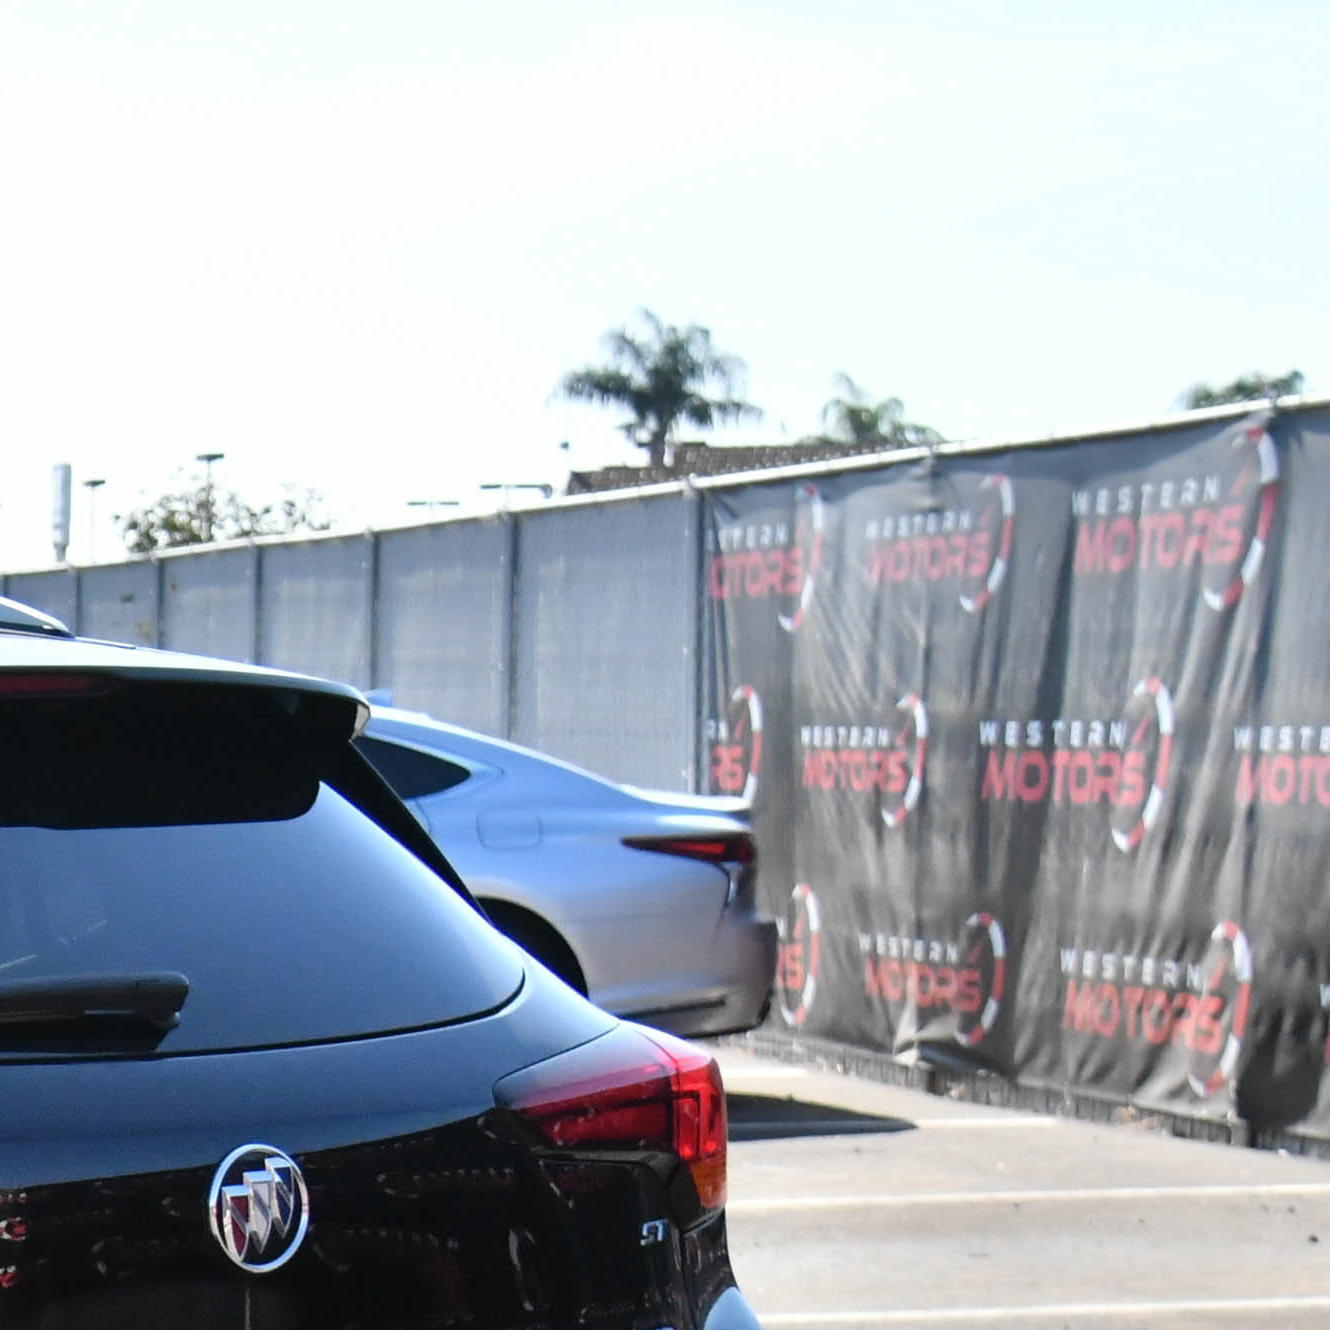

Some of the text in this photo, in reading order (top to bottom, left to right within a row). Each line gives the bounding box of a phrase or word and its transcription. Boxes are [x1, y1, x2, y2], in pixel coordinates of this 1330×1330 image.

[1072, 475, 1220, 516] WESTERN
[865, 509, 973, 540] WESTERN
[1074, 503, 1244, 575] MOTORS
[866, 531, 990, 588] MOTORS
[801, 725, 890, 748] WESTERN
[979, 720, 1127, 750] WESTERN
[801, 748, 907, 793] MOTORS
[981, 748, 1146, 806] MOTORS
[858, 932, 959, 963] WESTERN
[1060, 947, 1206, 991] WESTERN
[864, 953, 982, 1012] MOTORS
[1062, 977, 1224, 1055] MOTORS
